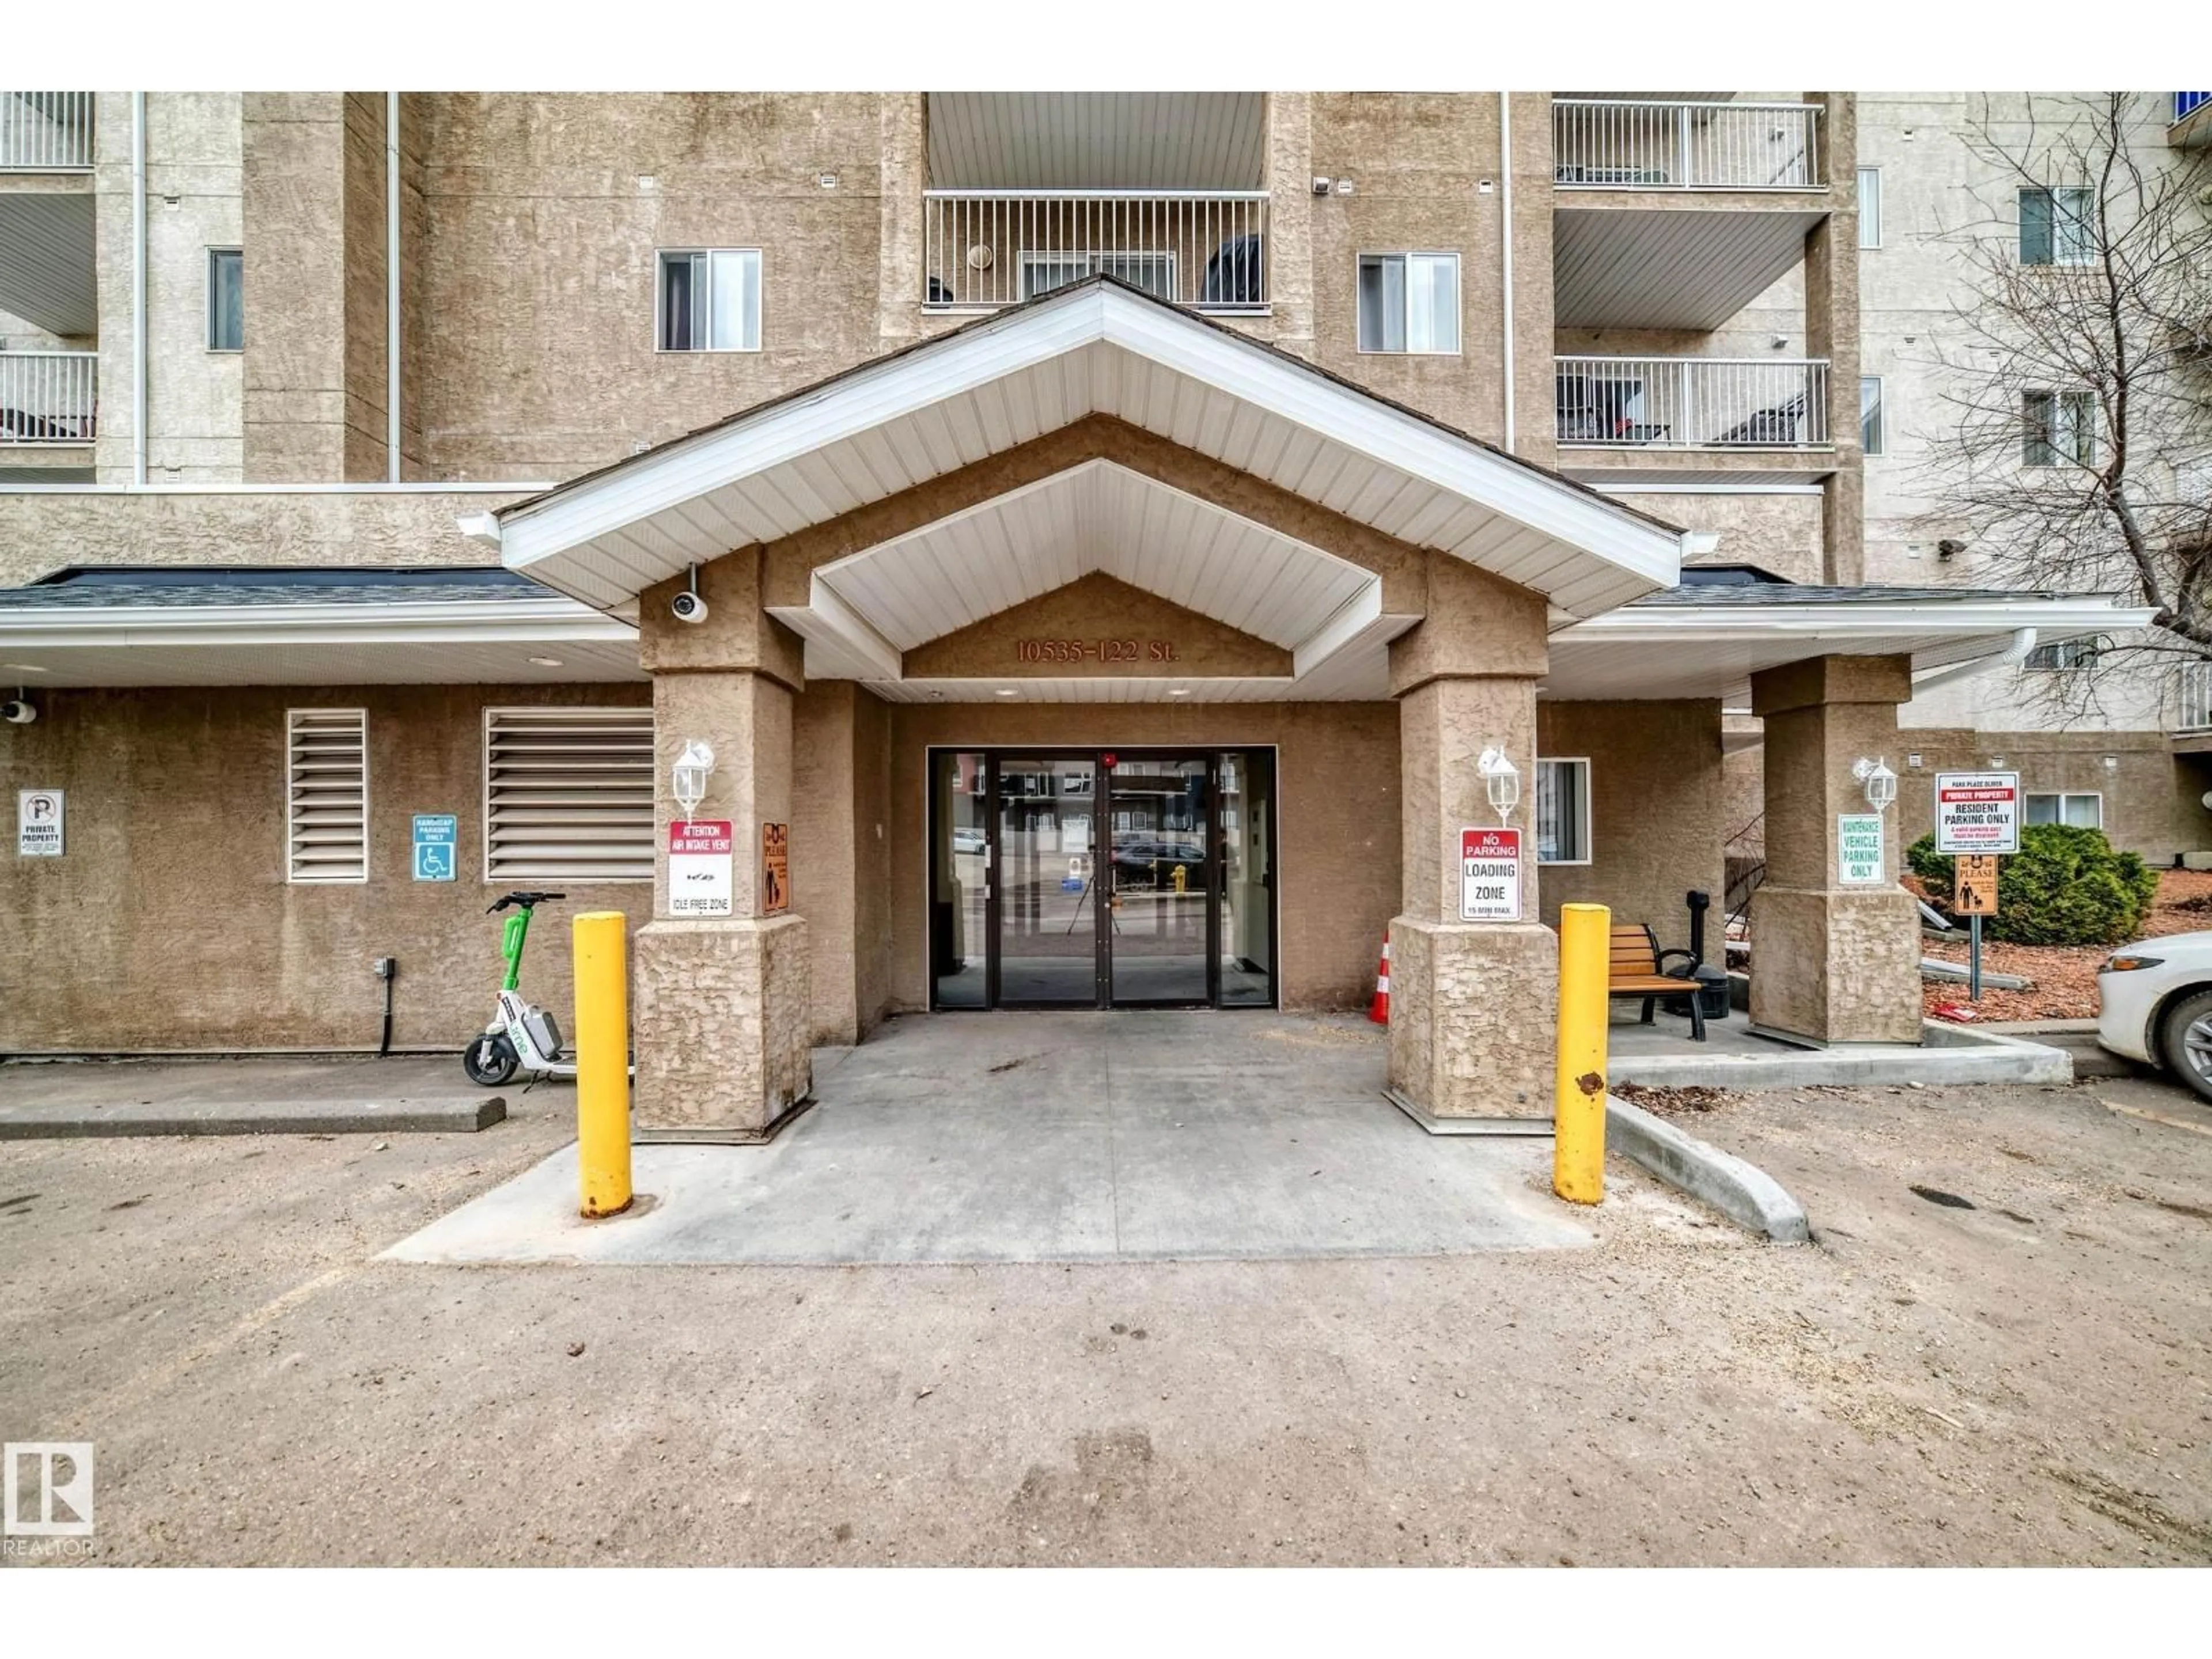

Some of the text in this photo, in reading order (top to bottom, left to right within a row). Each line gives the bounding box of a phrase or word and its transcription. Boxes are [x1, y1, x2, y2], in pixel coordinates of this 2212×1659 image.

[1018, 640, 1180, 662] 10535-122 St.
[1956, 803, 1998, 813] RESIDENT
[1945, 814, 2010, 825] PARKING ONLY
[26, 825, 56, 833] PRIVATE
[683, 825, 719, 836] ATTENTION
[672, 839, 730, 850] AIR INTAKE VENT
[1483, 836, 1499, 845] NO
[1844, 836, 1878, 847] VEHICLE
[1466, 846, 1516, 855] PARKING
[1844, 850, 1878, 862] PARKING
[1465, 864, 1515, 877] LOADING
[1851, 865, 1872, 877] ONLY
[1475, 886, 1505, 899] ZONE
[673, 899, 728, 909] IDLE FREE ZONE
